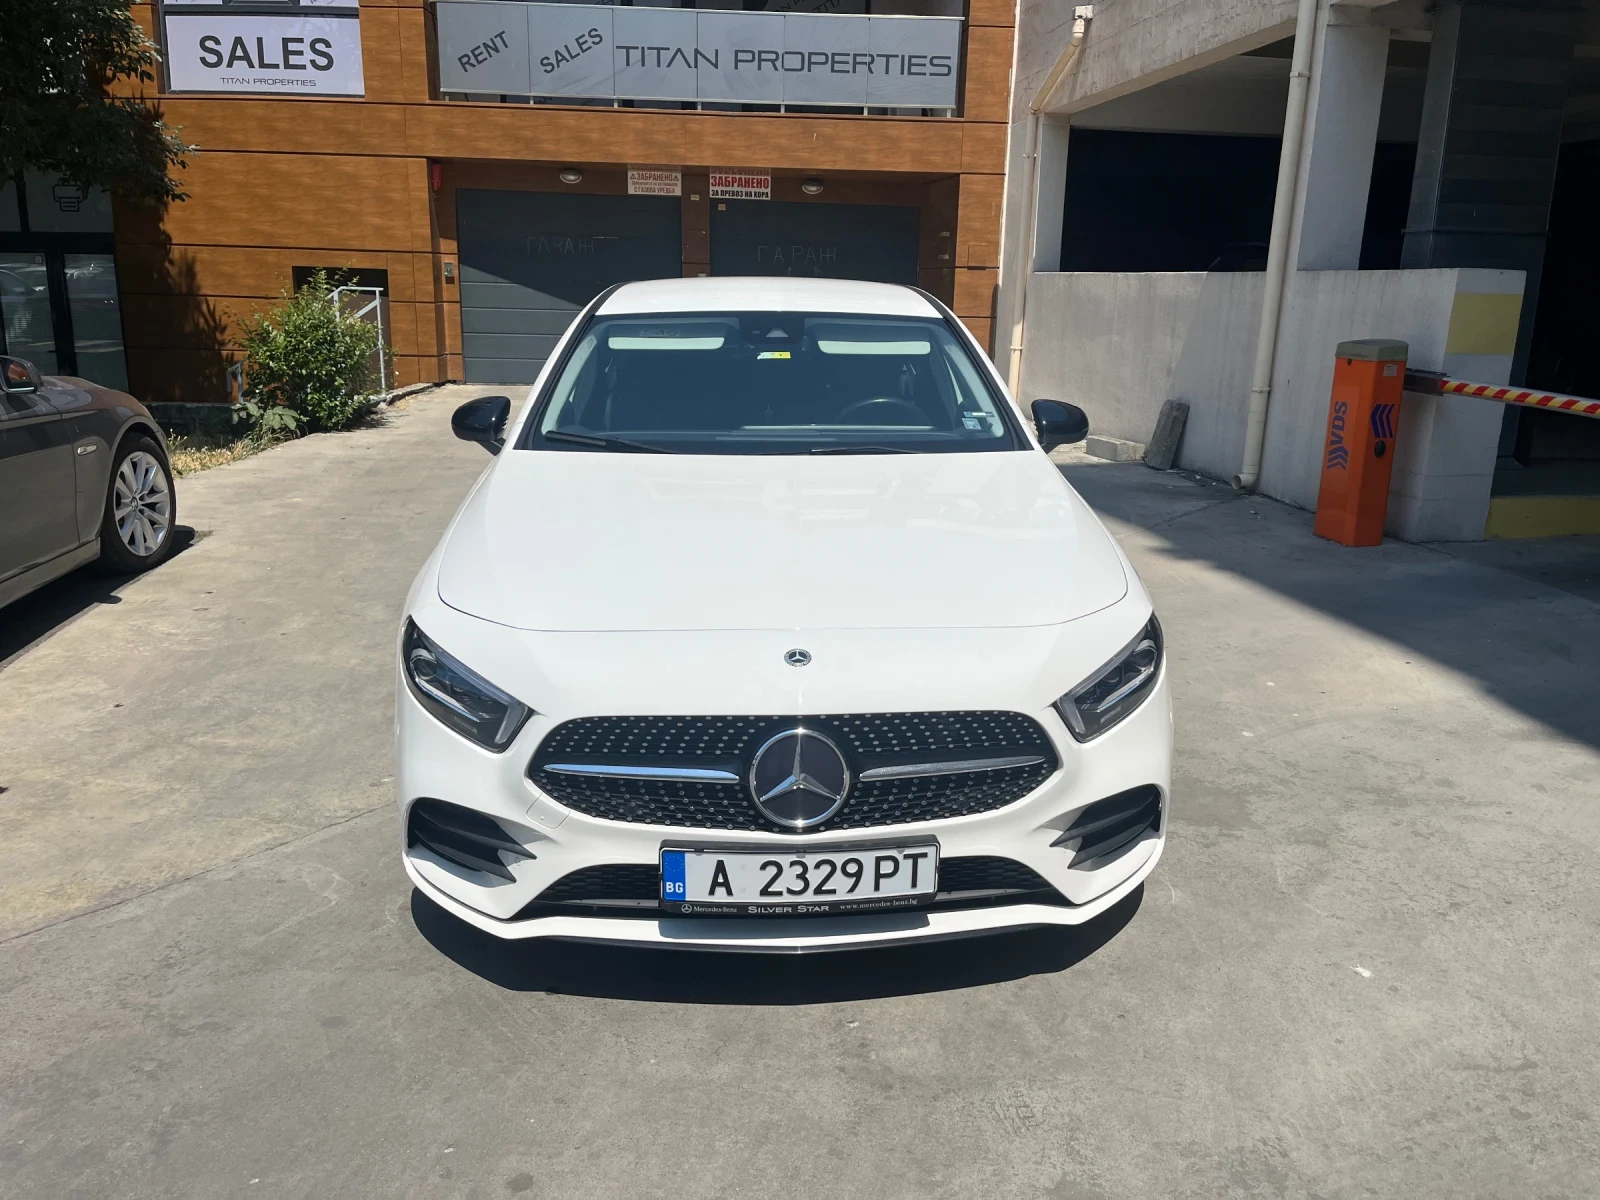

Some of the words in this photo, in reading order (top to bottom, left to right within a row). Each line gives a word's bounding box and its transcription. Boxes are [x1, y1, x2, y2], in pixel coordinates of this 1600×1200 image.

[199, 35, 334, 71] SALES
[457, 30, 510, 73] RENT
[539, 27, 604, 74] SALES
[616, 45, 719, 70] TITAN
[734, 49, 952, 77] PROPERTIES
[220, 77, 250, 85] TITAN
[253, 78, 317, 87] PROPERTIES
[636, 172, 673, 182] ЗАБРАНЕНО
[711, 175, 770, 189] ЗАБРАНЕНО
[711, 189, 720, 197] ЗА
[720, 190, 744, 198] ПРЕВОЗ
[744, 190, 753, 198] НА
[753, 191, 769, 199] ХОРА
[1329, 400, 1348, 446] VDS
[665, 881, 684, 894] BG
[708, 859, 734, 897] A
[693, 905, 738, 913] Mercedes-Benz
[747, 905, 793, 914] SILVER
[840, 898, 918, 910] www.mercedes-benz.bg
